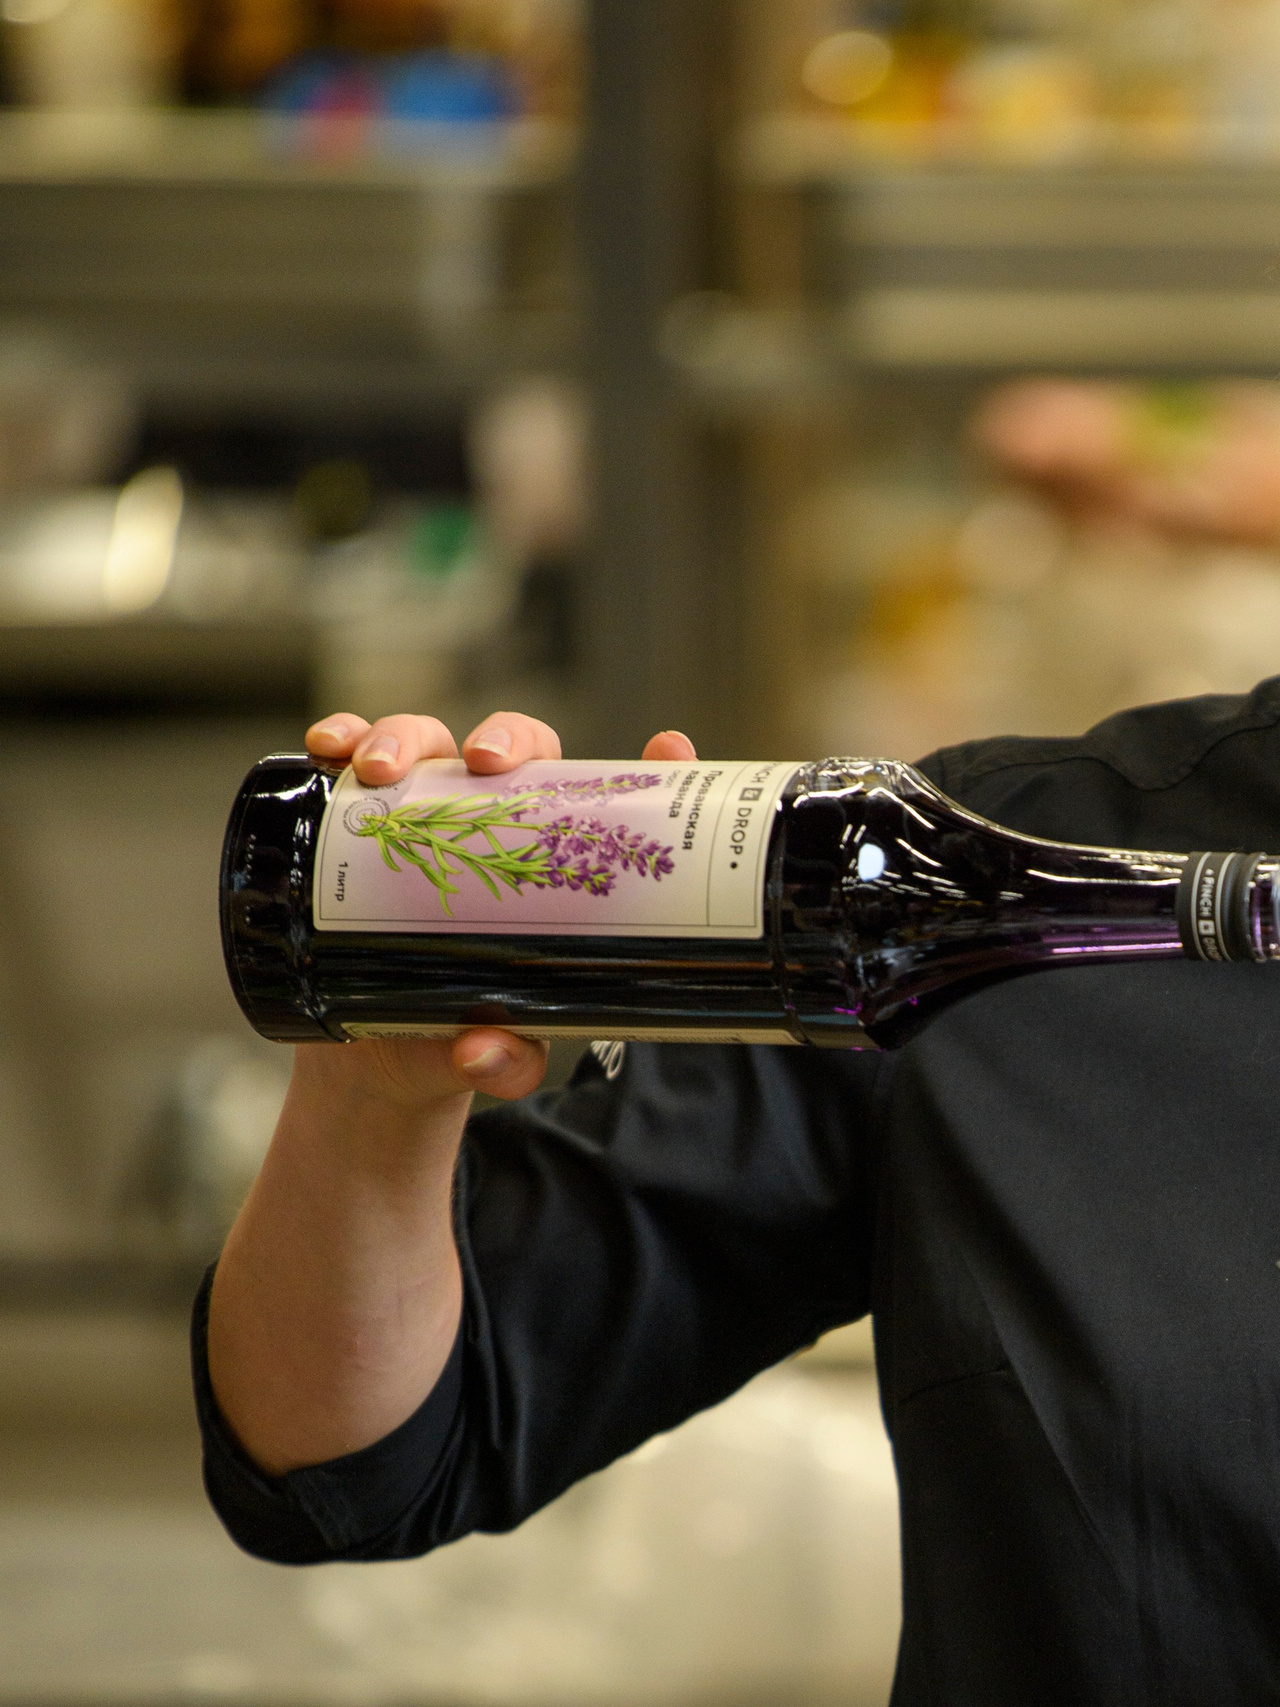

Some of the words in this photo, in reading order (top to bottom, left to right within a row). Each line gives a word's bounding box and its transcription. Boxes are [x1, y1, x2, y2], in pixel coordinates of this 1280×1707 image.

[682, 770, 723, 850] Прованская
[729, 807, 752, 855] DROP
[334, 870, 347, 902] литр
[338, 861, 349, 869] 1
[1200, 876, 1215, 918] PINCH
